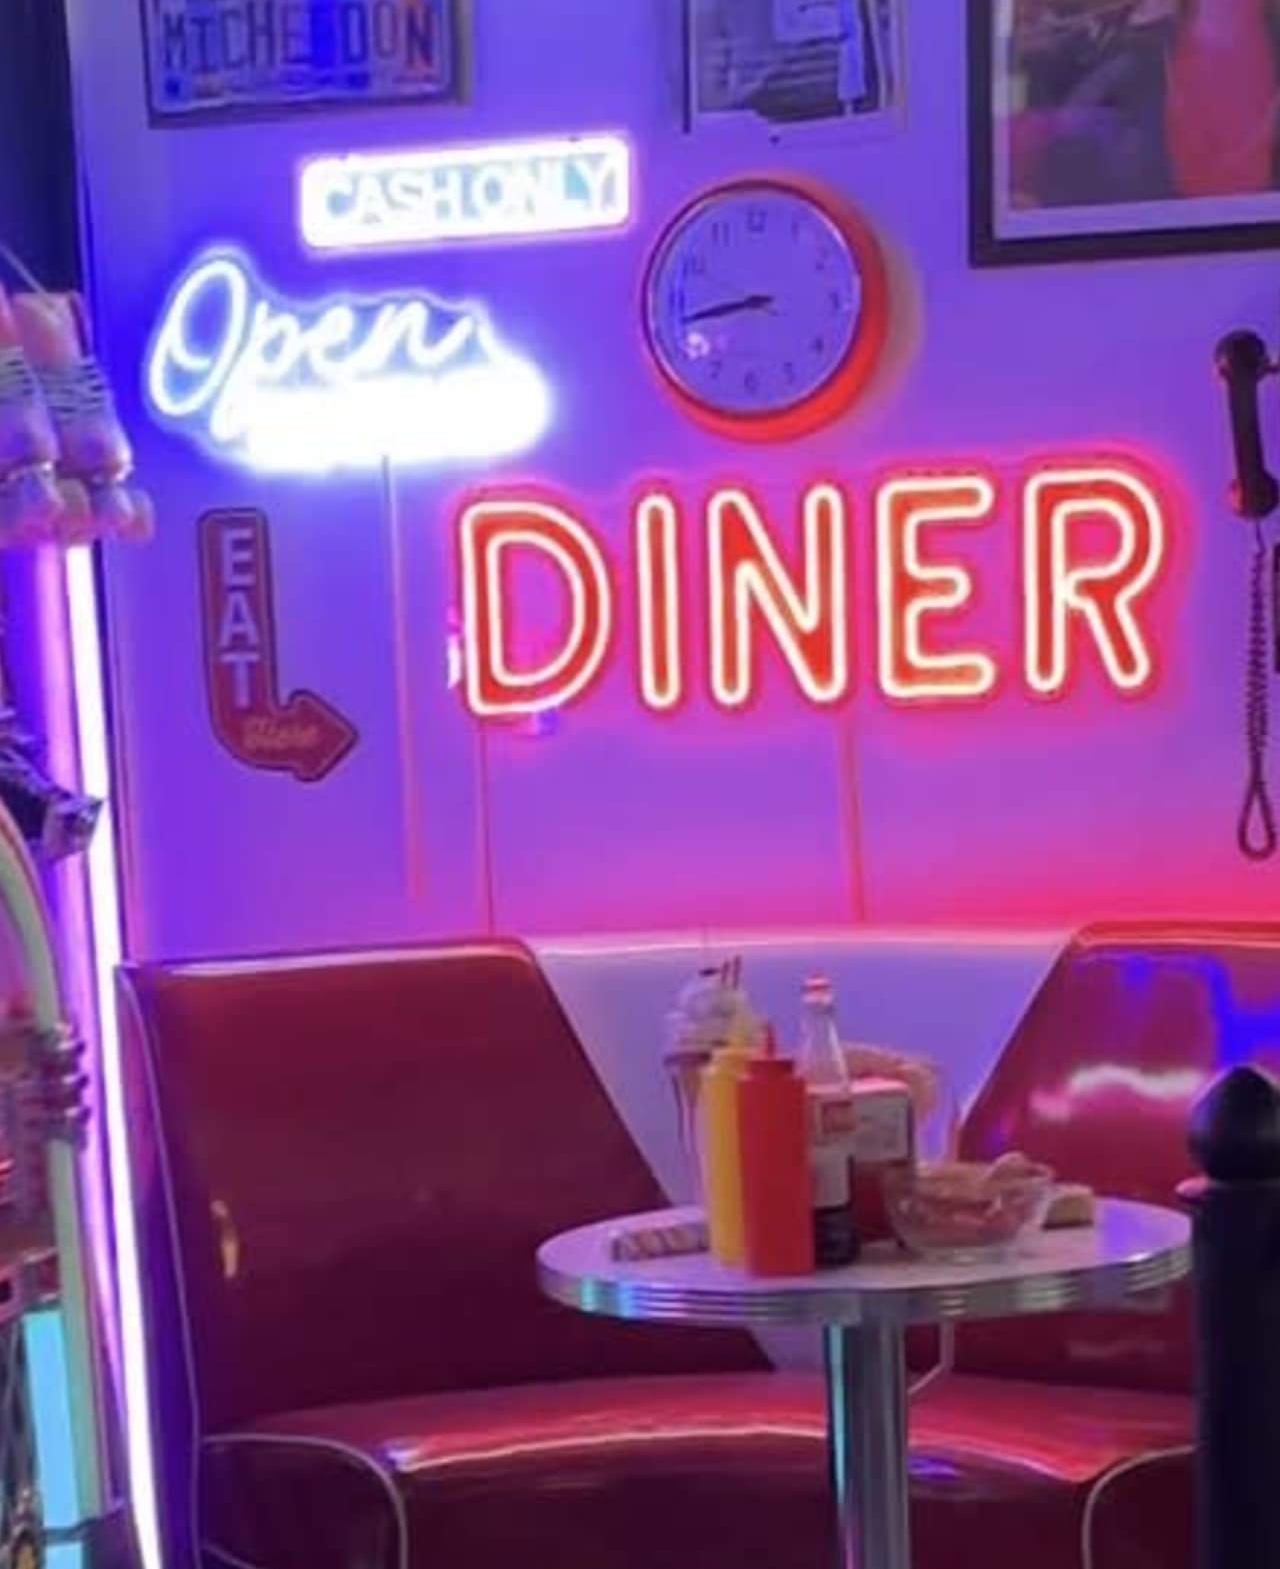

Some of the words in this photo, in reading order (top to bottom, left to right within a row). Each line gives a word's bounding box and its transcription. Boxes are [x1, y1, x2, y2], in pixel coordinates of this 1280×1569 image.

[312, 162, 463, 231] CASH
[471, 153, 619, 223] ONLY
[149, 258, 473, 441] Open
[219, 528, 261, 710] EAT
[459, 467, 1164, 715] DINER
